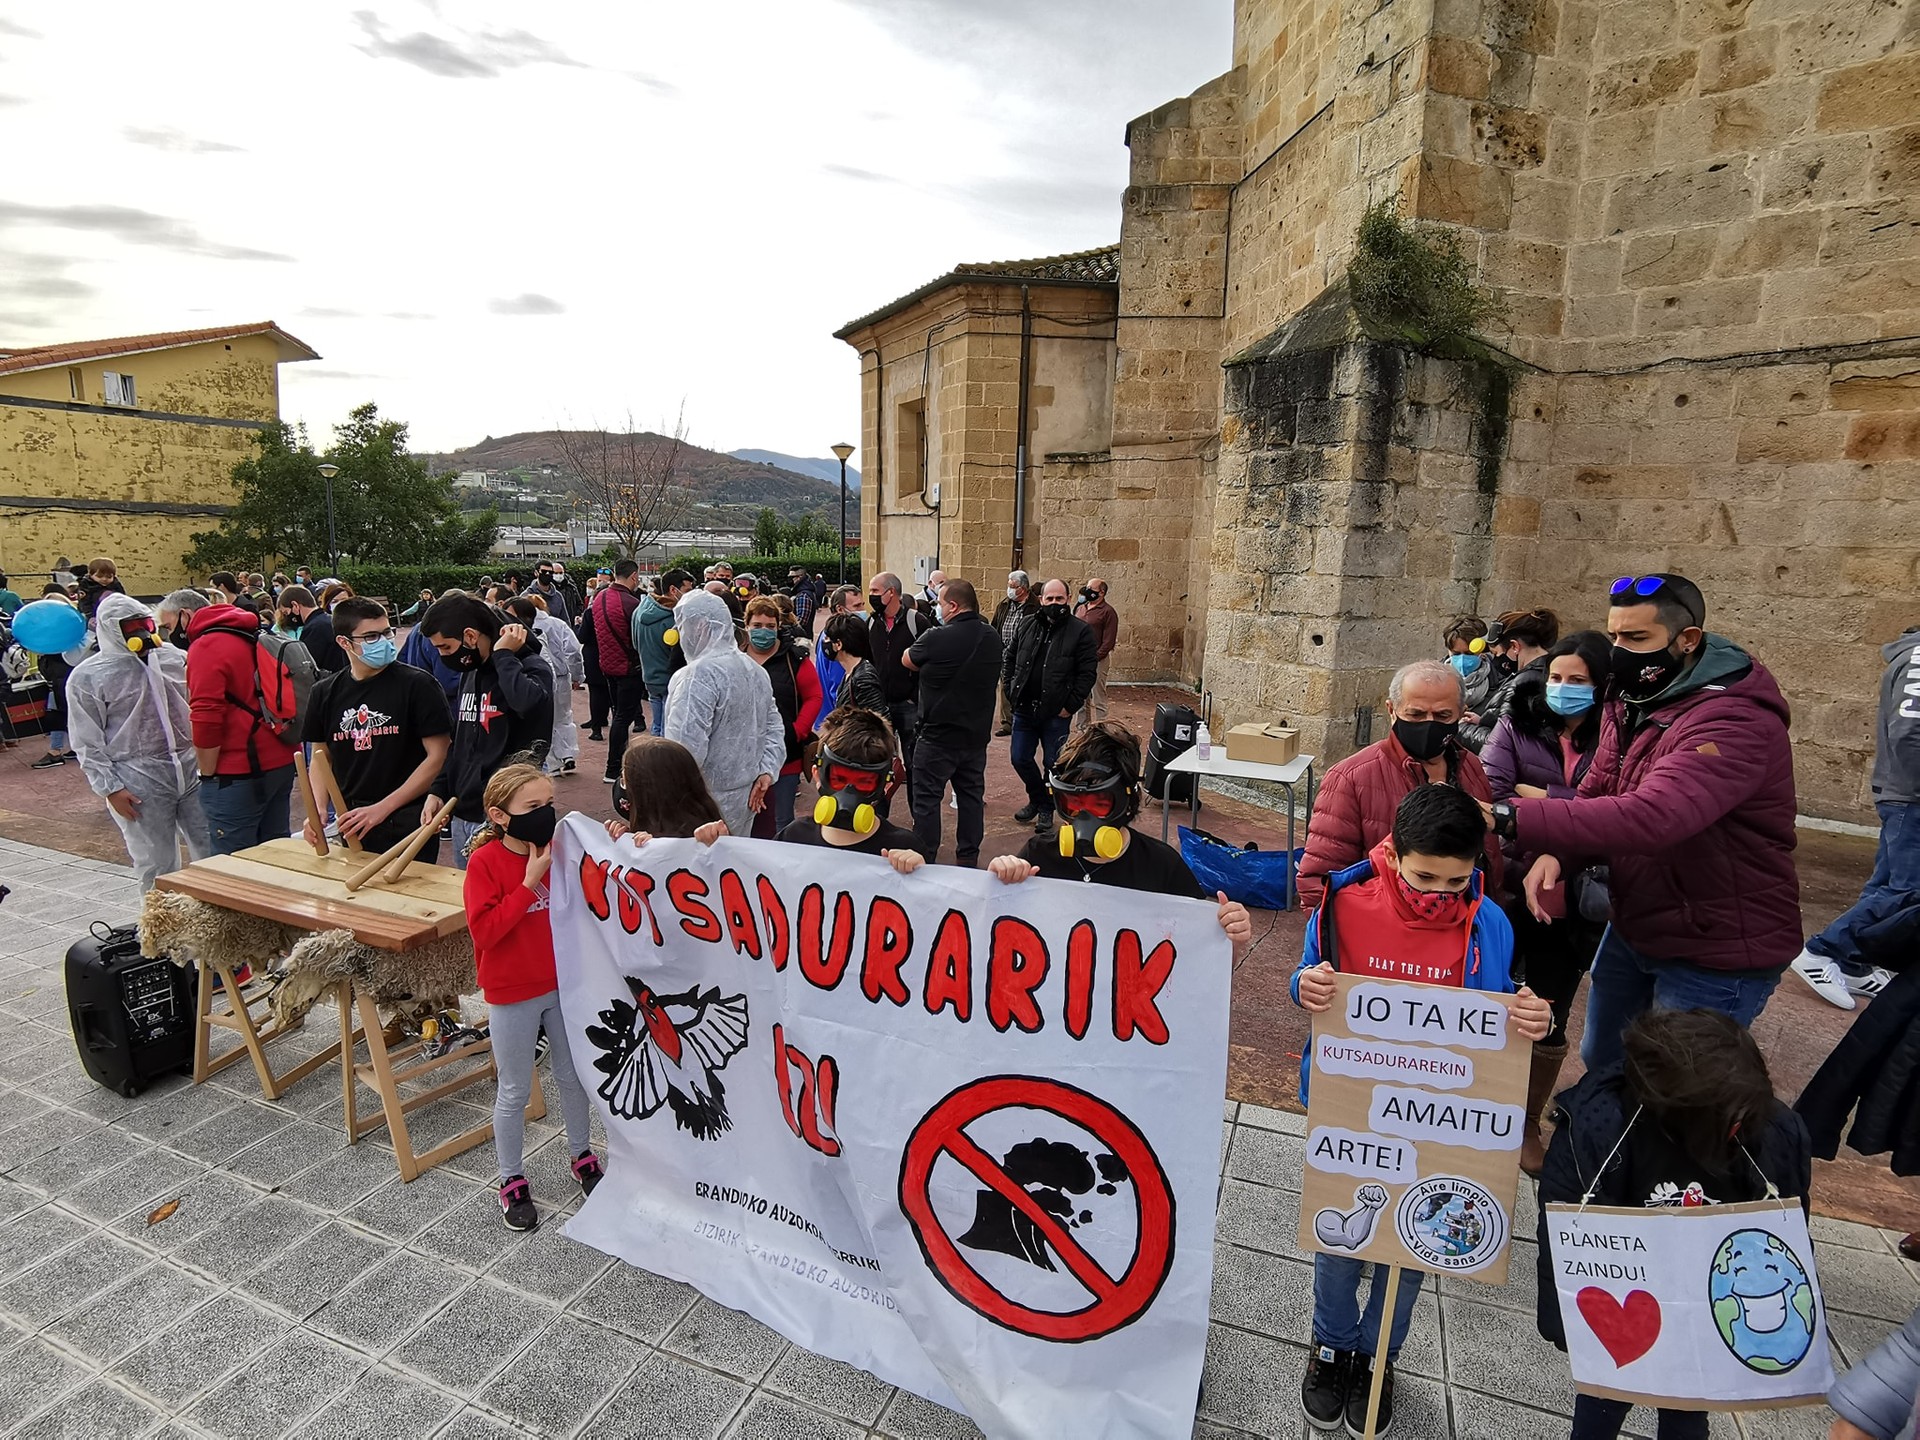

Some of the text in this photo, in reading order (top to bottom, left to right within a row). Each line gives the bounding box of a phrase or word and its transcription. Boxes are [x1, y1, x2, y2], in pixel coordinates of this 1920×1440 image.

[1368, 956, 1395, 971] PLAY
[1401, 962, 1421, 976] THE
[1351, 994, 1499, 1037] JO TA KE
[1323, 1045, 1467, 1077] KUTSADURAREKIN
[1382, 1096, 1512, 1137] AMAITU
[1315, 1136, 1403, 1171] ARTE!
[695, 1181, 768, 1215] ERANDIOKO
[1420, 1182, 1489, 1207] Aire limpio
[1413, 1240, 1476, 1266] Vida sana
[1560, 1231, 1647, 1252] PLANETA
[1564, 1260, 1647, 1282] ZAINDU!
